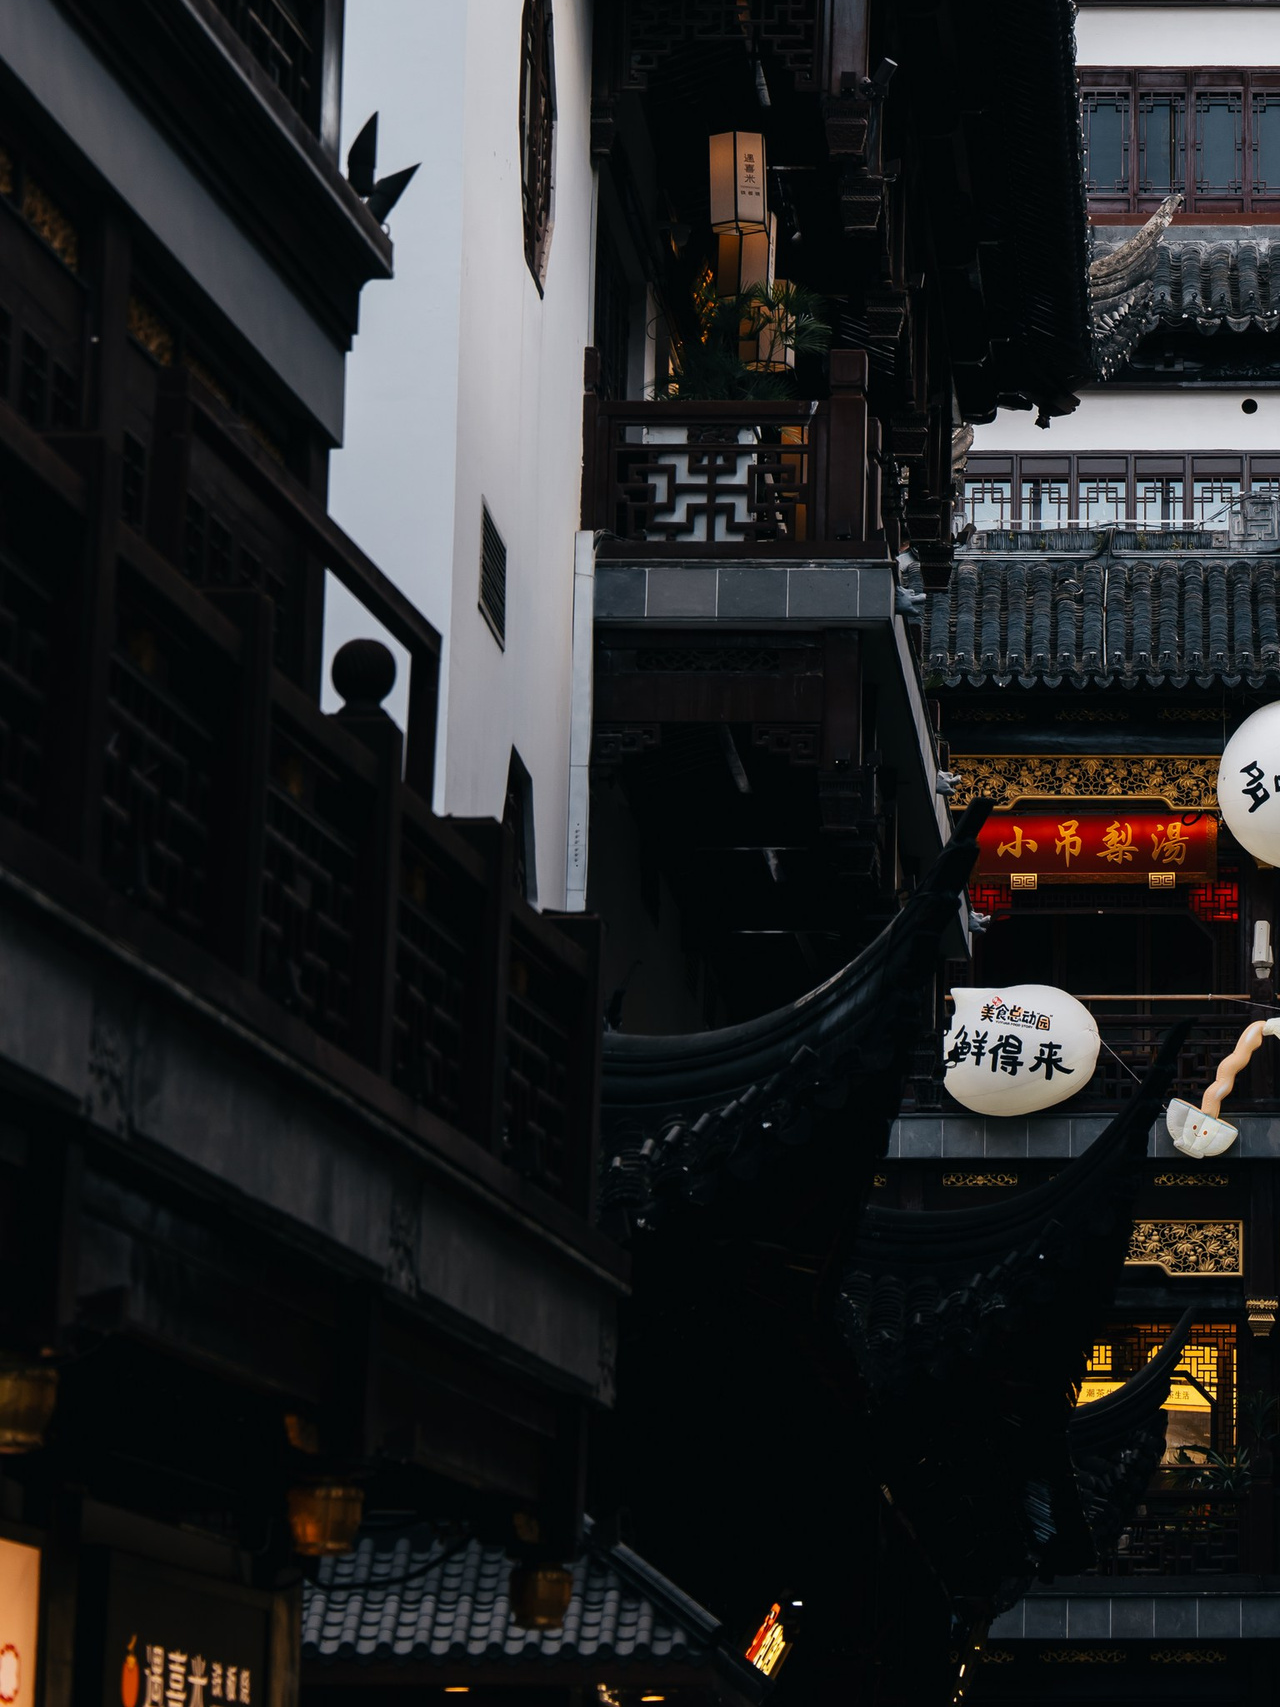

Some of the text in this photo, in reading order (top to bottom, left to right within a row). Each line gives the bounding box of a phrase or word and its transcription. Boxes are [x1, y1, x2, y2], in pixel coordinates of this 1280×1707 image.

[997, 819, 1190, 868] 小吊梨湯
[947, 1024, 1075, 1080] 鲜得来
